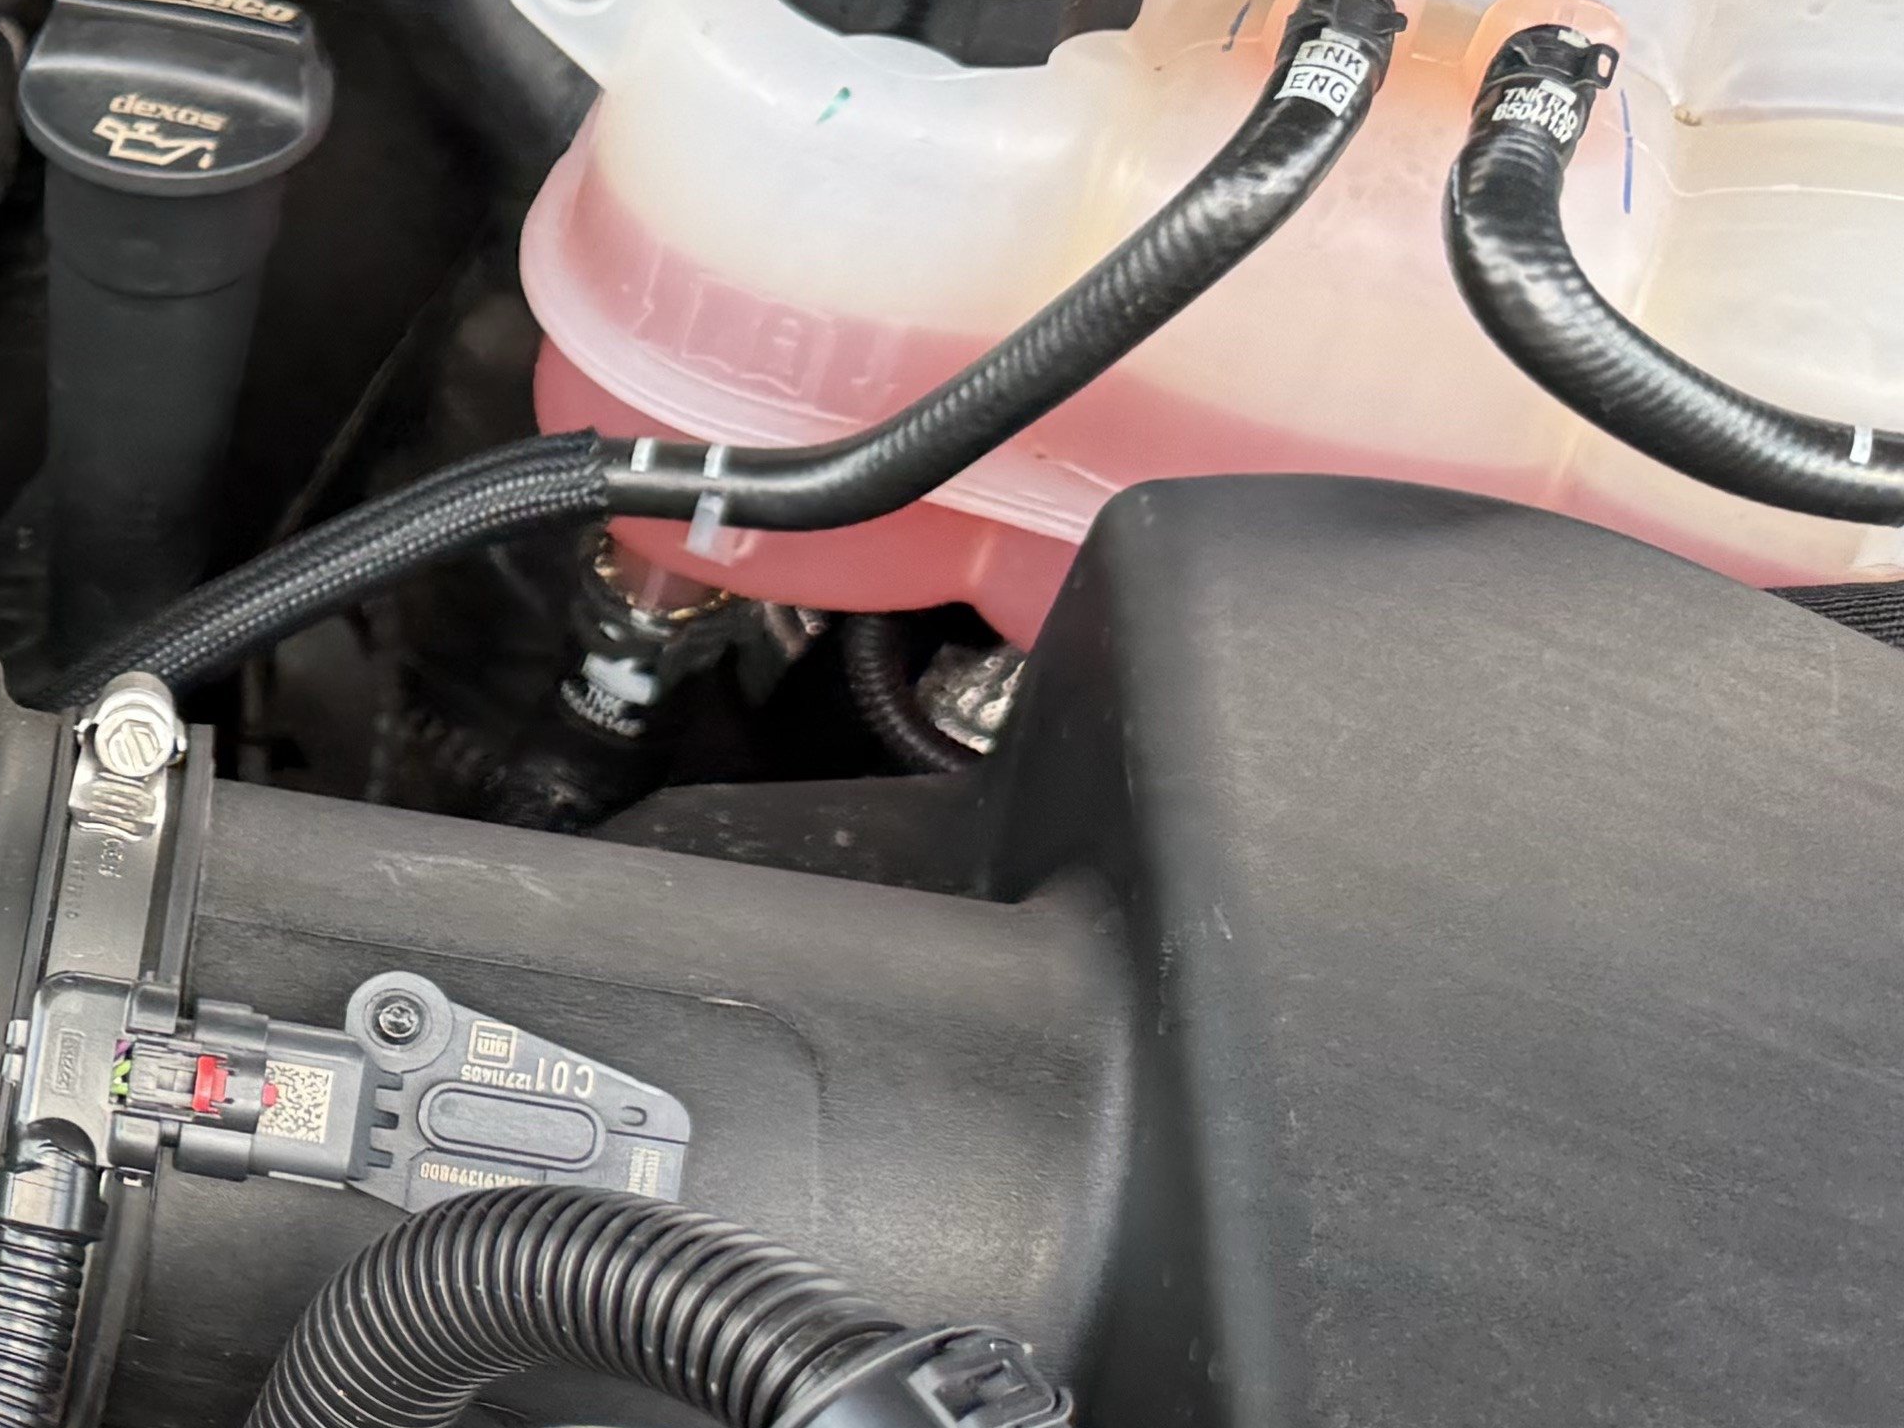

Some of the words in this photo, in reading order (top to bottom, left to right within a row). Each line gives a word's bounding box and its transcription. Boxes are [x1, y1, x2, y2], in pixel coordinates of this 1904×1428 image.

[1304, 43, 1363, 75] TNK
[1288, 72, 1349, 104] ENG
[109, 93, 228, 132] dexos
